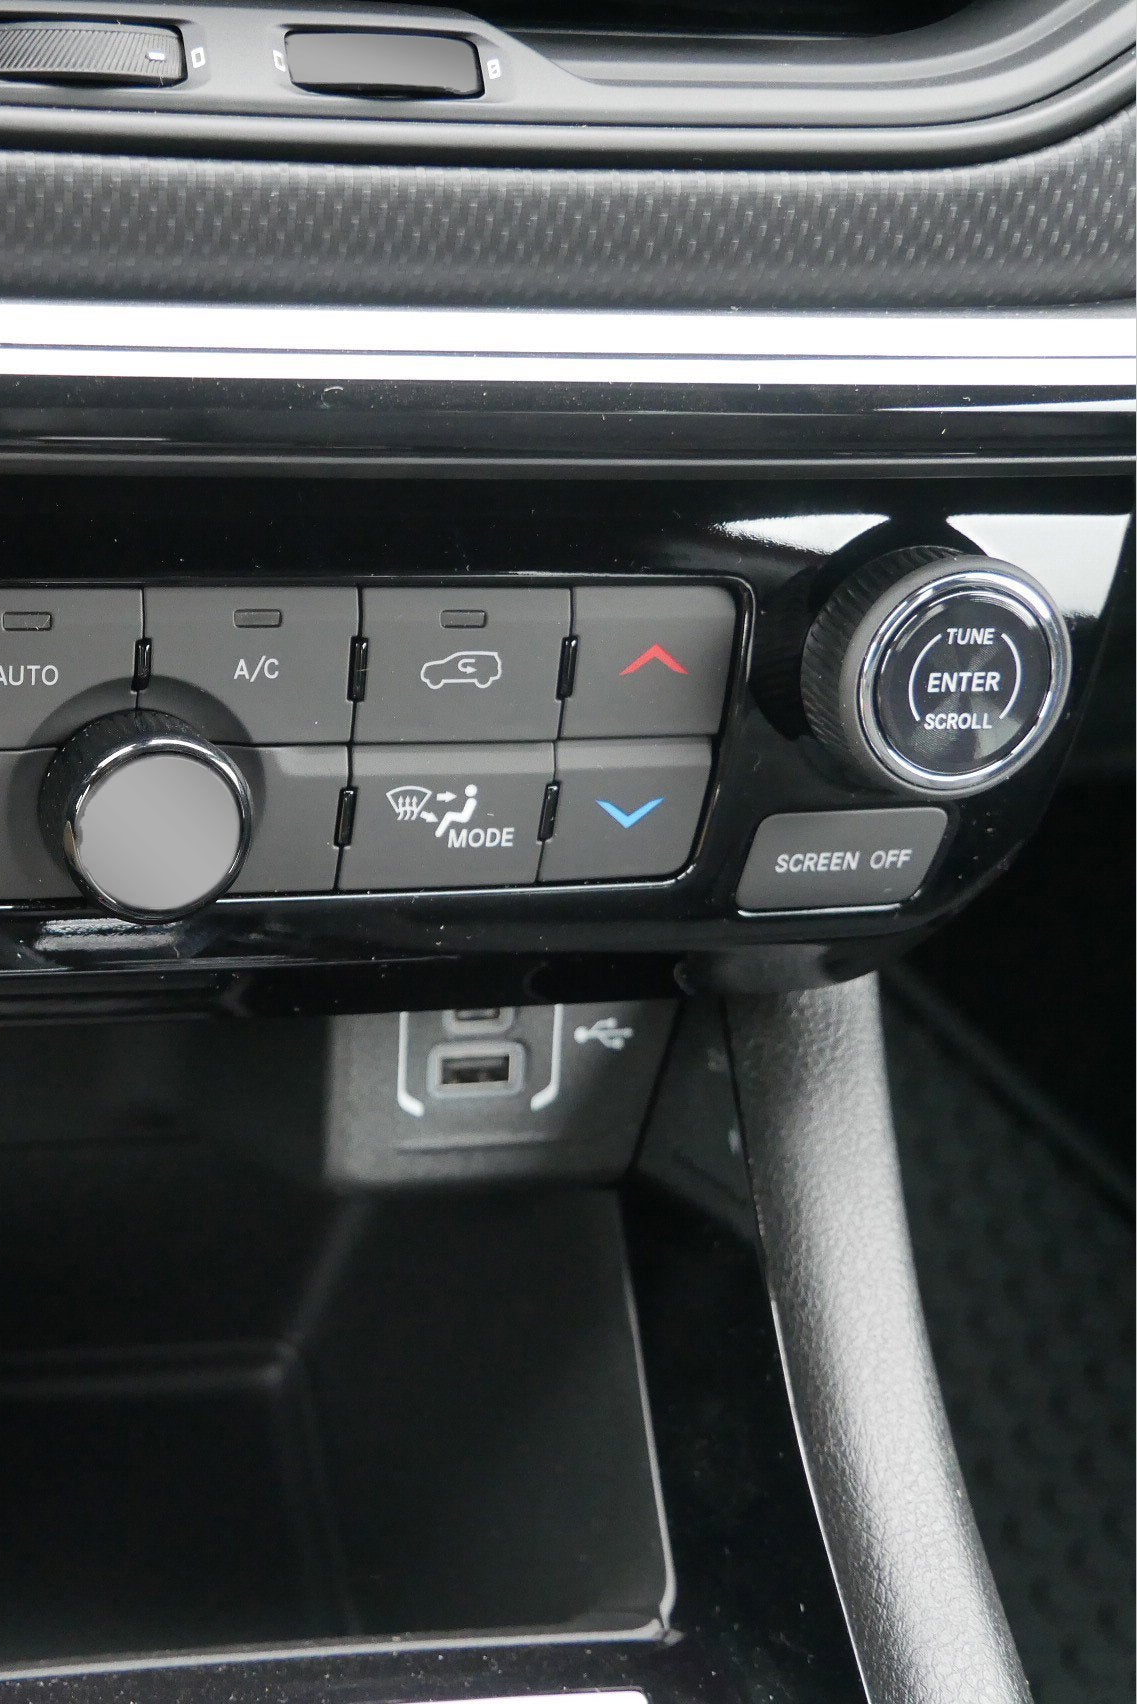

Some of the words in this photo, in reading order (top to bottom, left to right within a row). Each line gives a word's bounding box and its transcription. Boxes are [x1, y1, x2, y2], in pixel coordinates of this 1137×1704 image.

[945, 627, 996, 646] TUNE
[233, 655, 279, 683] A/C
[926, 671, 1001, 693] ENTER
[923, 712, 993, 730] SCROLL
[447, 827, 515, 848] MODE
[774, 851, 860, 873] SCREEN
[869, 848, 912, 869] OFF
